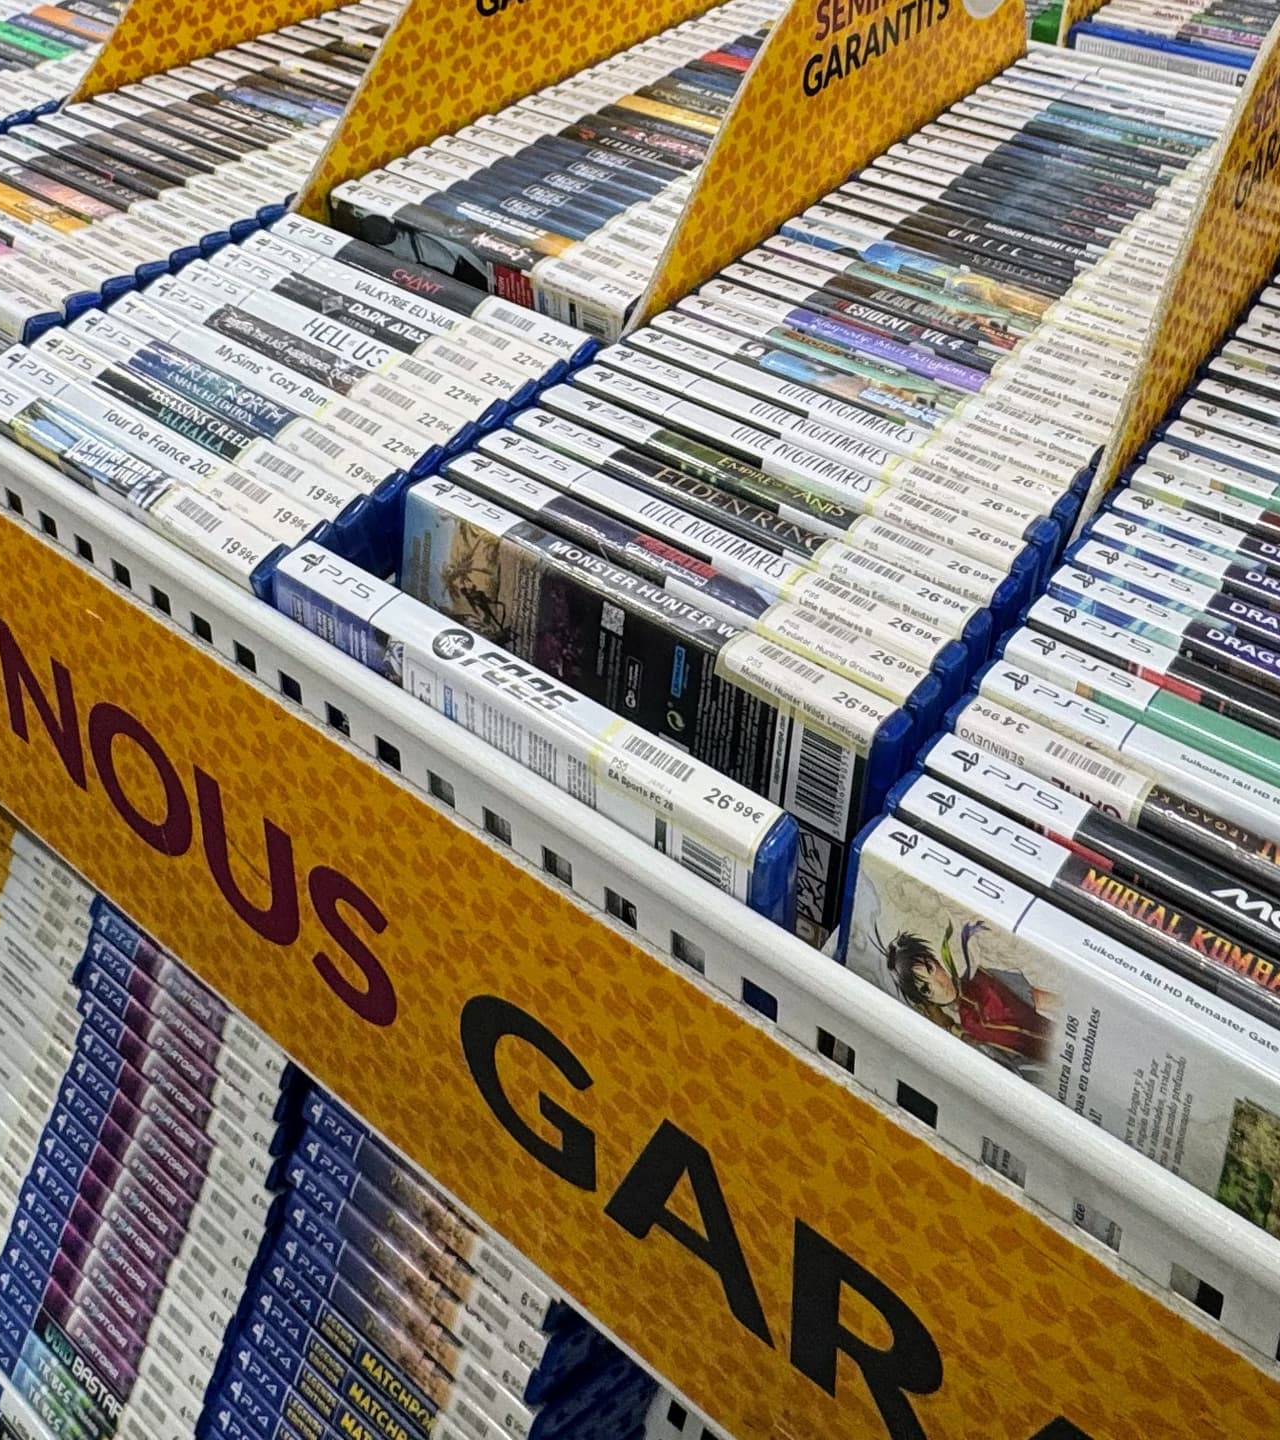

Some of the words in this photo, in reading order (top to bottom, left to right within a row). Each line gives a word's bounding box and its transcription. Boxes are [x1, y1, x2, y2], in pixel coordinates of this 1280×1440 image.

[348, 301, 389, 328] DARK
[353, 279, 407, 311] VALKYRIE
[301, 317, 347, 351] HELL
[215, 342, 265, 382] MySims
[269, 371, 304, 402] Cozy
[143, 431, 189, 471] France
[156, 407, 226, 452] VALHALLA
[717, 456, 771, 485] EMPIRE
[731, 426, 779, 455] LITTLE
[782, 440, 874, 494] NIGHTMARES
[653, 466, 744, 520] ELDEN
[641, 500, 689, 534] LITTLE
[687, 518, 790, 580] NIGHTMARES
[547, 539, 639, 592] MONSTER
[635, 581, 716, 629] HUNTER
[461, 650, 578, 713] FC26
[1079, 869, 1183, 943] MORTAL
[1081, 937, 1138, 975] Suikoden
[1184, 992, 1247, 1034] Remaster
[1248, 1028, 1280, 1053] Gate
[1080, 1007, 1102, 1075] combates
